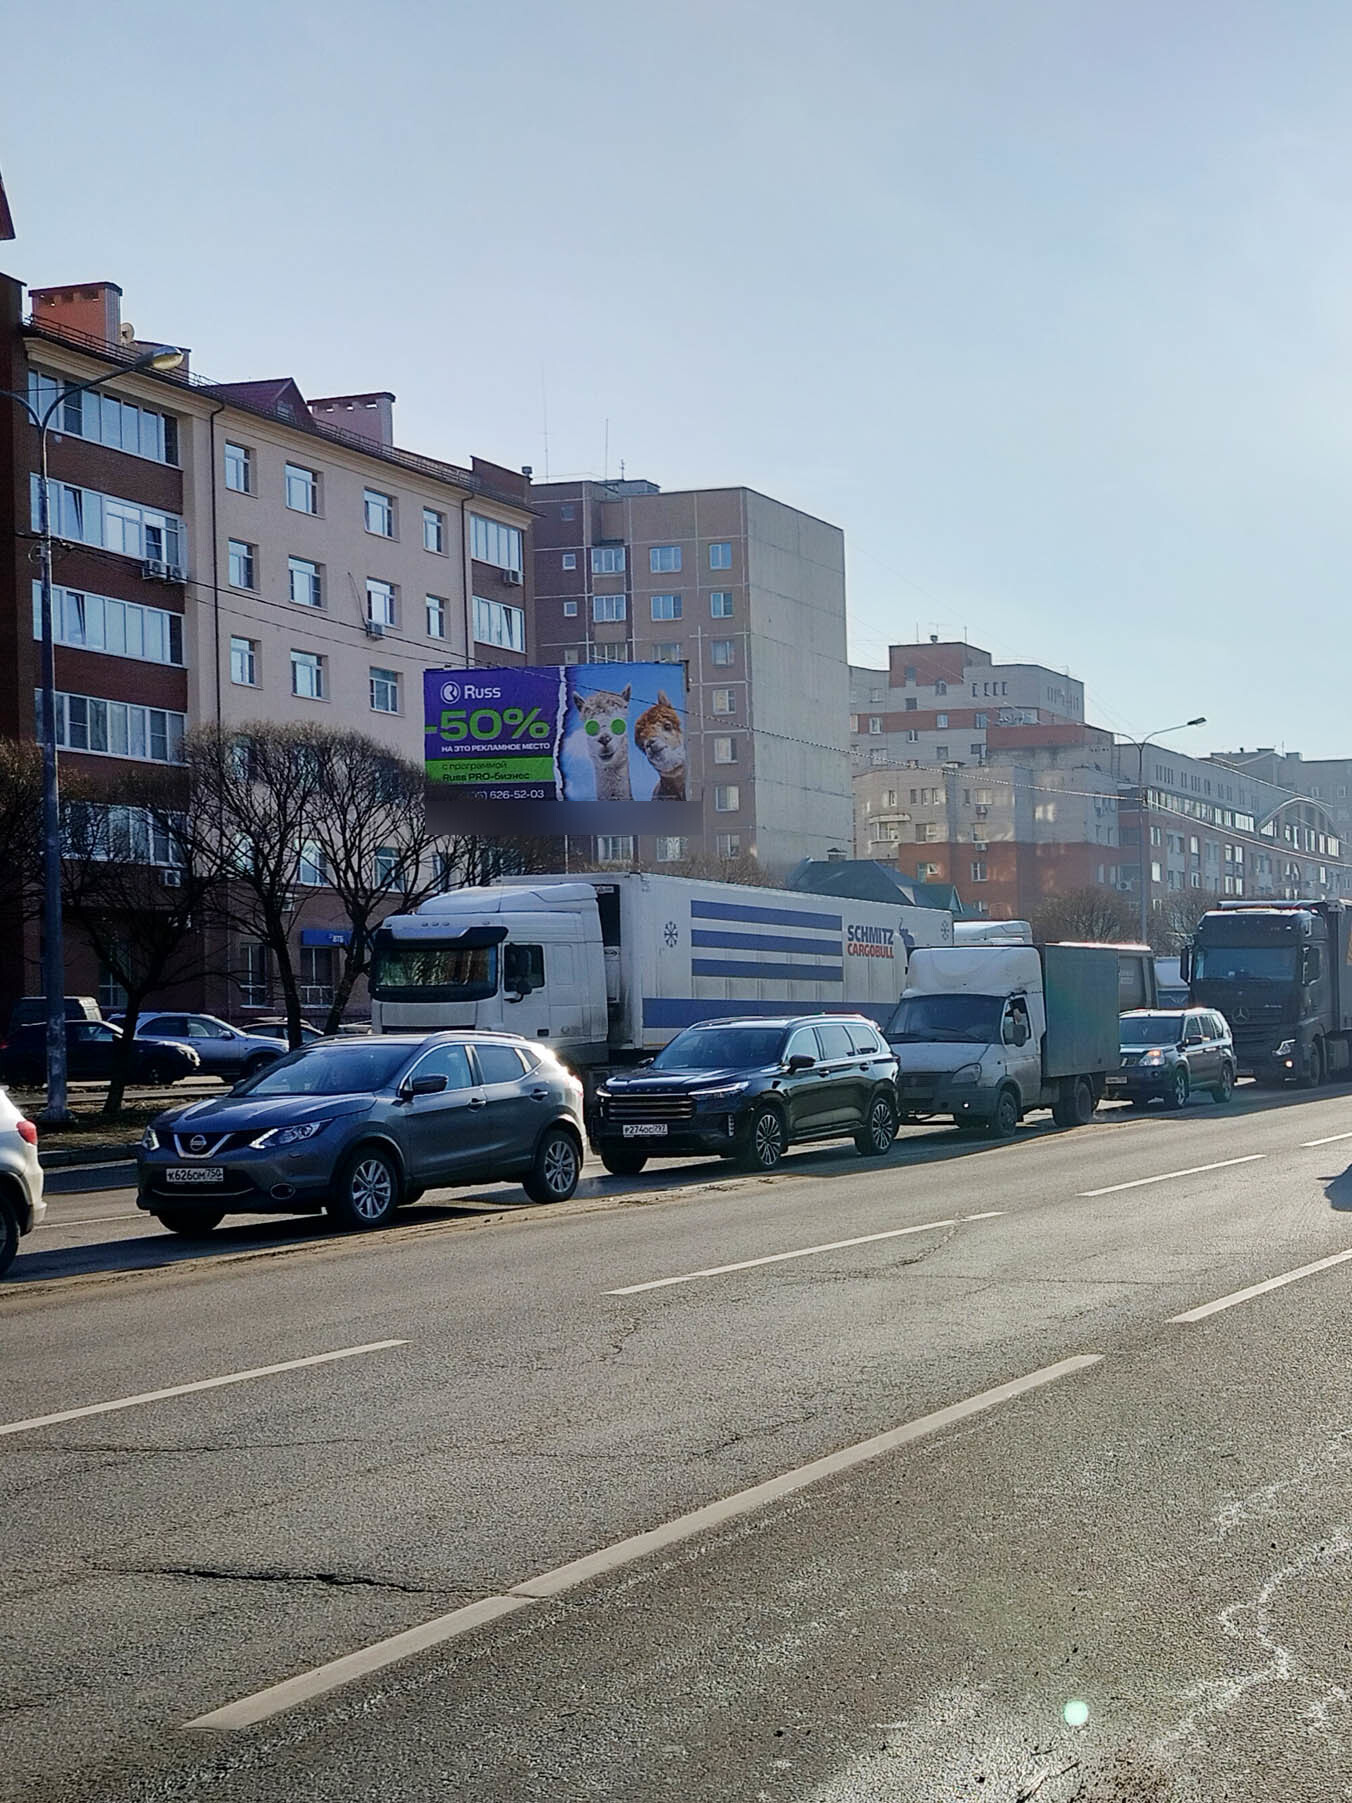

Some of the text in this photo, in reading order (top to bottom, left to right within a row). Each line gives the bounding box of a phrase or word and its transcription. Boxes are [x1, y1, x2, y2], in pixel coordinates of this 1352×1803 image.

[464, 685, 501, 699] Russ
[425, 707, 550, 741] -50%
[441, 742, 550, 753] НА ЭТО РЕКЛАМНОЕ МЕСТО
[449, 761, 507, 771] программой
[468, 772, 530, 781] PRO-бизнес
[489, 789, 545, 799] 626-52-03
[847, 924, 894, 945] SCHMITZ
[847, 943, 894, 959] CARGOBULL
